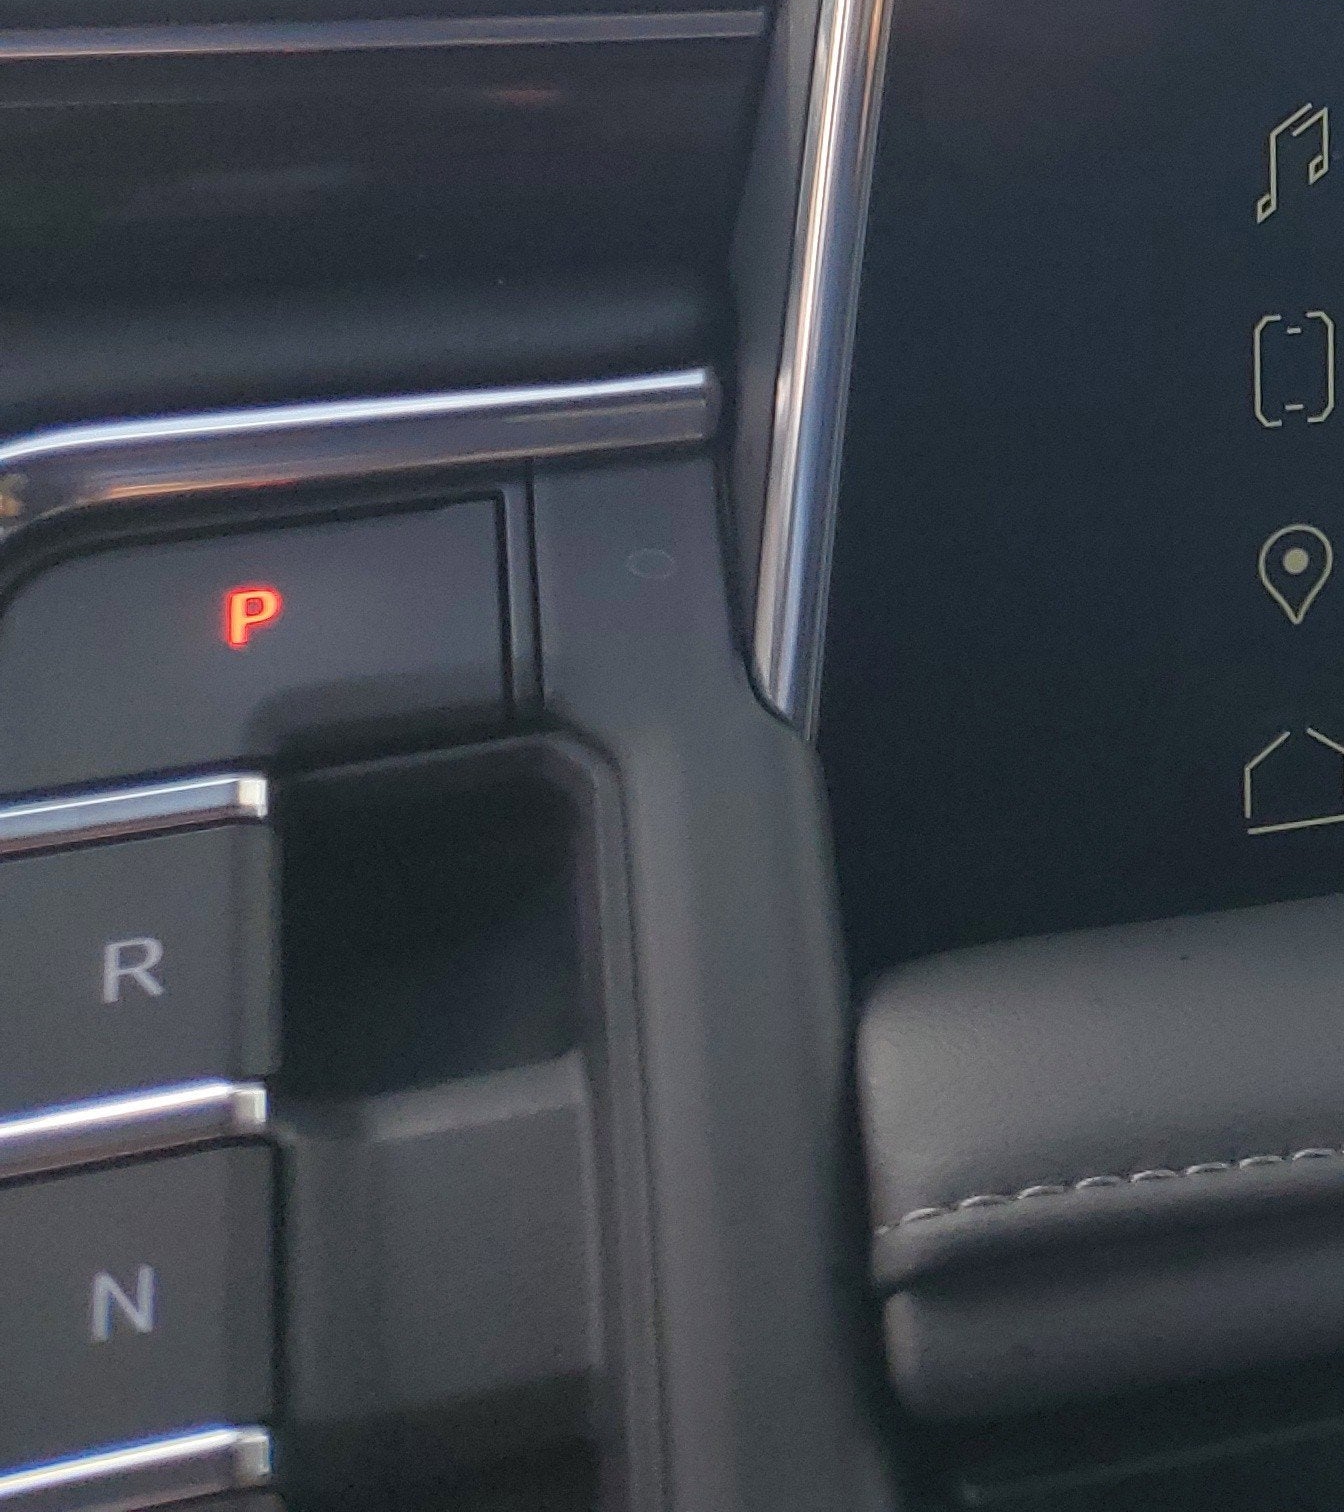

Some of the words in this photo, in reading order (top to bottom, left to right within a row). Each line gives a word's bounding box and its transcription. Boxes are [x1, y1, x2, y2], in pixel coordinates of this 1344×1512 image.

[221, 584, 285, 650] P
[103, 936, 164, 1003] R
[91, 1265, 156, 1340] N
